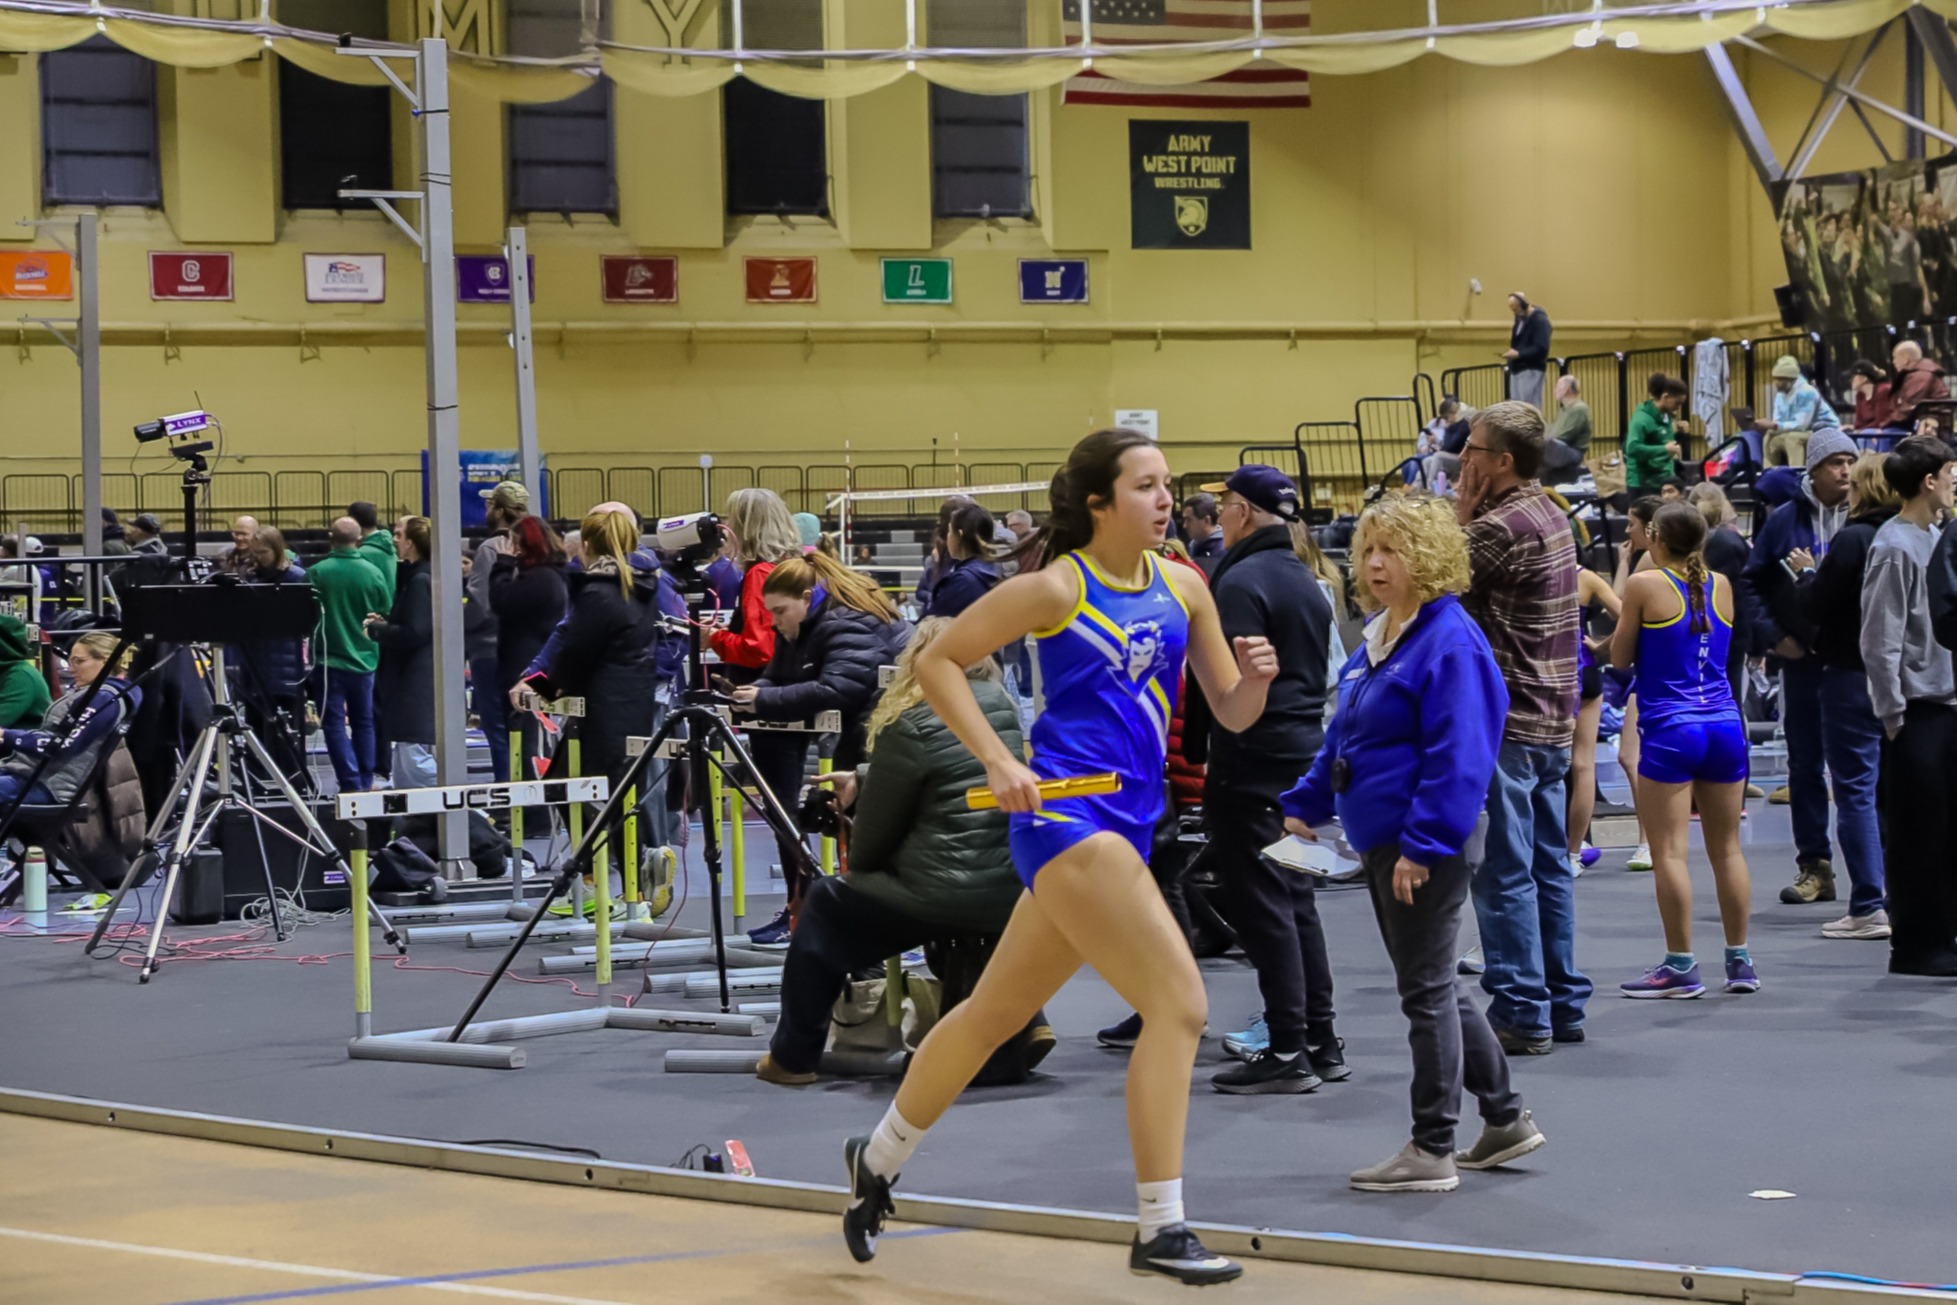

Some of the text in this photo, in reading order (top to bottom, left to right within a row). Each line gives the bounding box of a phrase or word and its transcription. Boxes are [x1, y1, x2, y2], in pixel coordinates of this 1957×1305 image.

[1168, 134, 1211, 152] ARMY
[1143, 155, 1236, 174] WEST POINT
[1154, 177, 1220, 189] WRESTLING
[177, 417, 201, 428] LYNX
[442, 787, 511, 810] UCS
